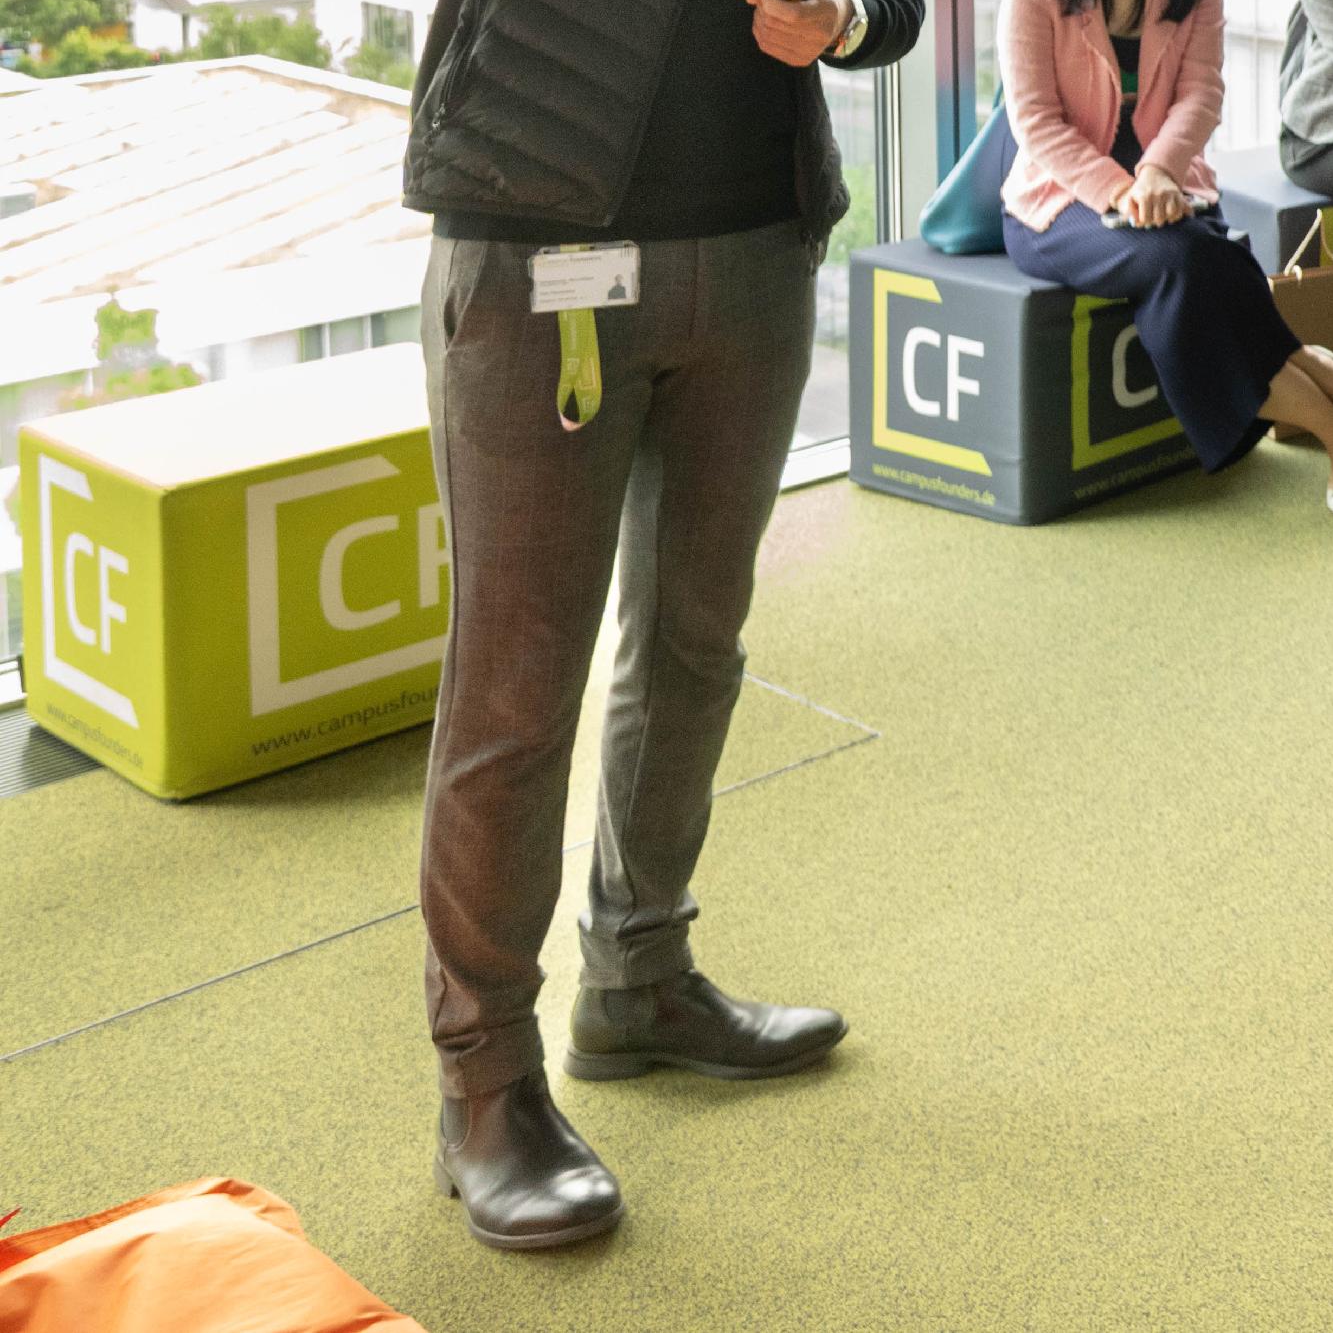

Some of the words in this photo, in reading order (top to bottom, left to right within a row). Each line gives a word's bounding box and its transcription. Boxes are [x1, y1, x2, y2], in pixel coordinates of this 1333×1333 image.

[903, 327, 984, 422] CF
[872, 463, 996, 507] www.campusfounders.de
[64, 532, 129, 655] CF
